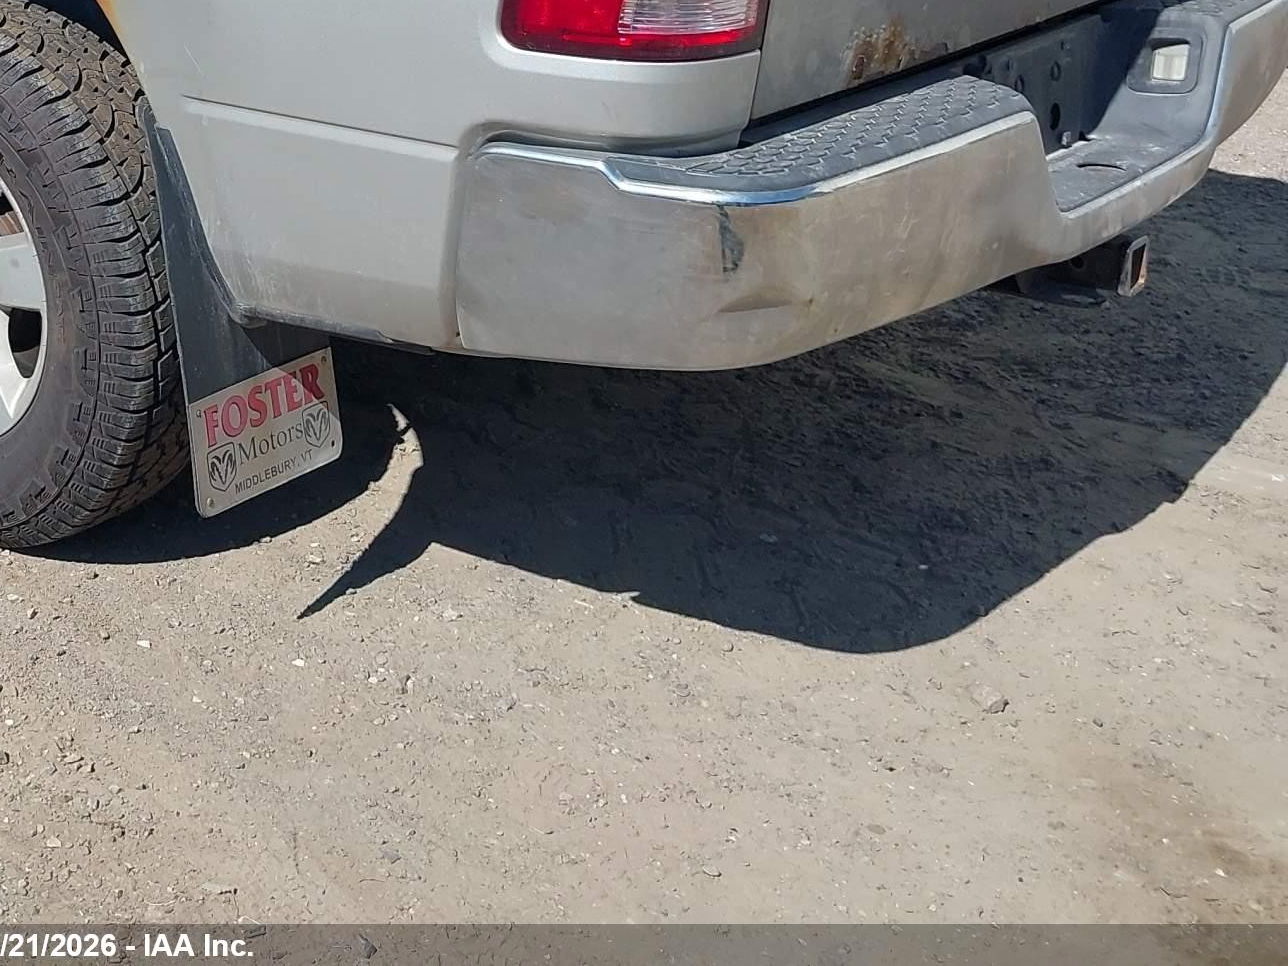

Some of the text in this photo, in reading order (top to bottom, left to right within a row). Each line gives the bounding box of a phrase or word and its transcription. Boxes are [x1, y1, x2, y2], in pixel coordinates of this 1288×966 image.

[202, 362, 325, 448] FOSTER
[237, 422, 304, 466] Motors
[301, 448, 314, 464] VT
